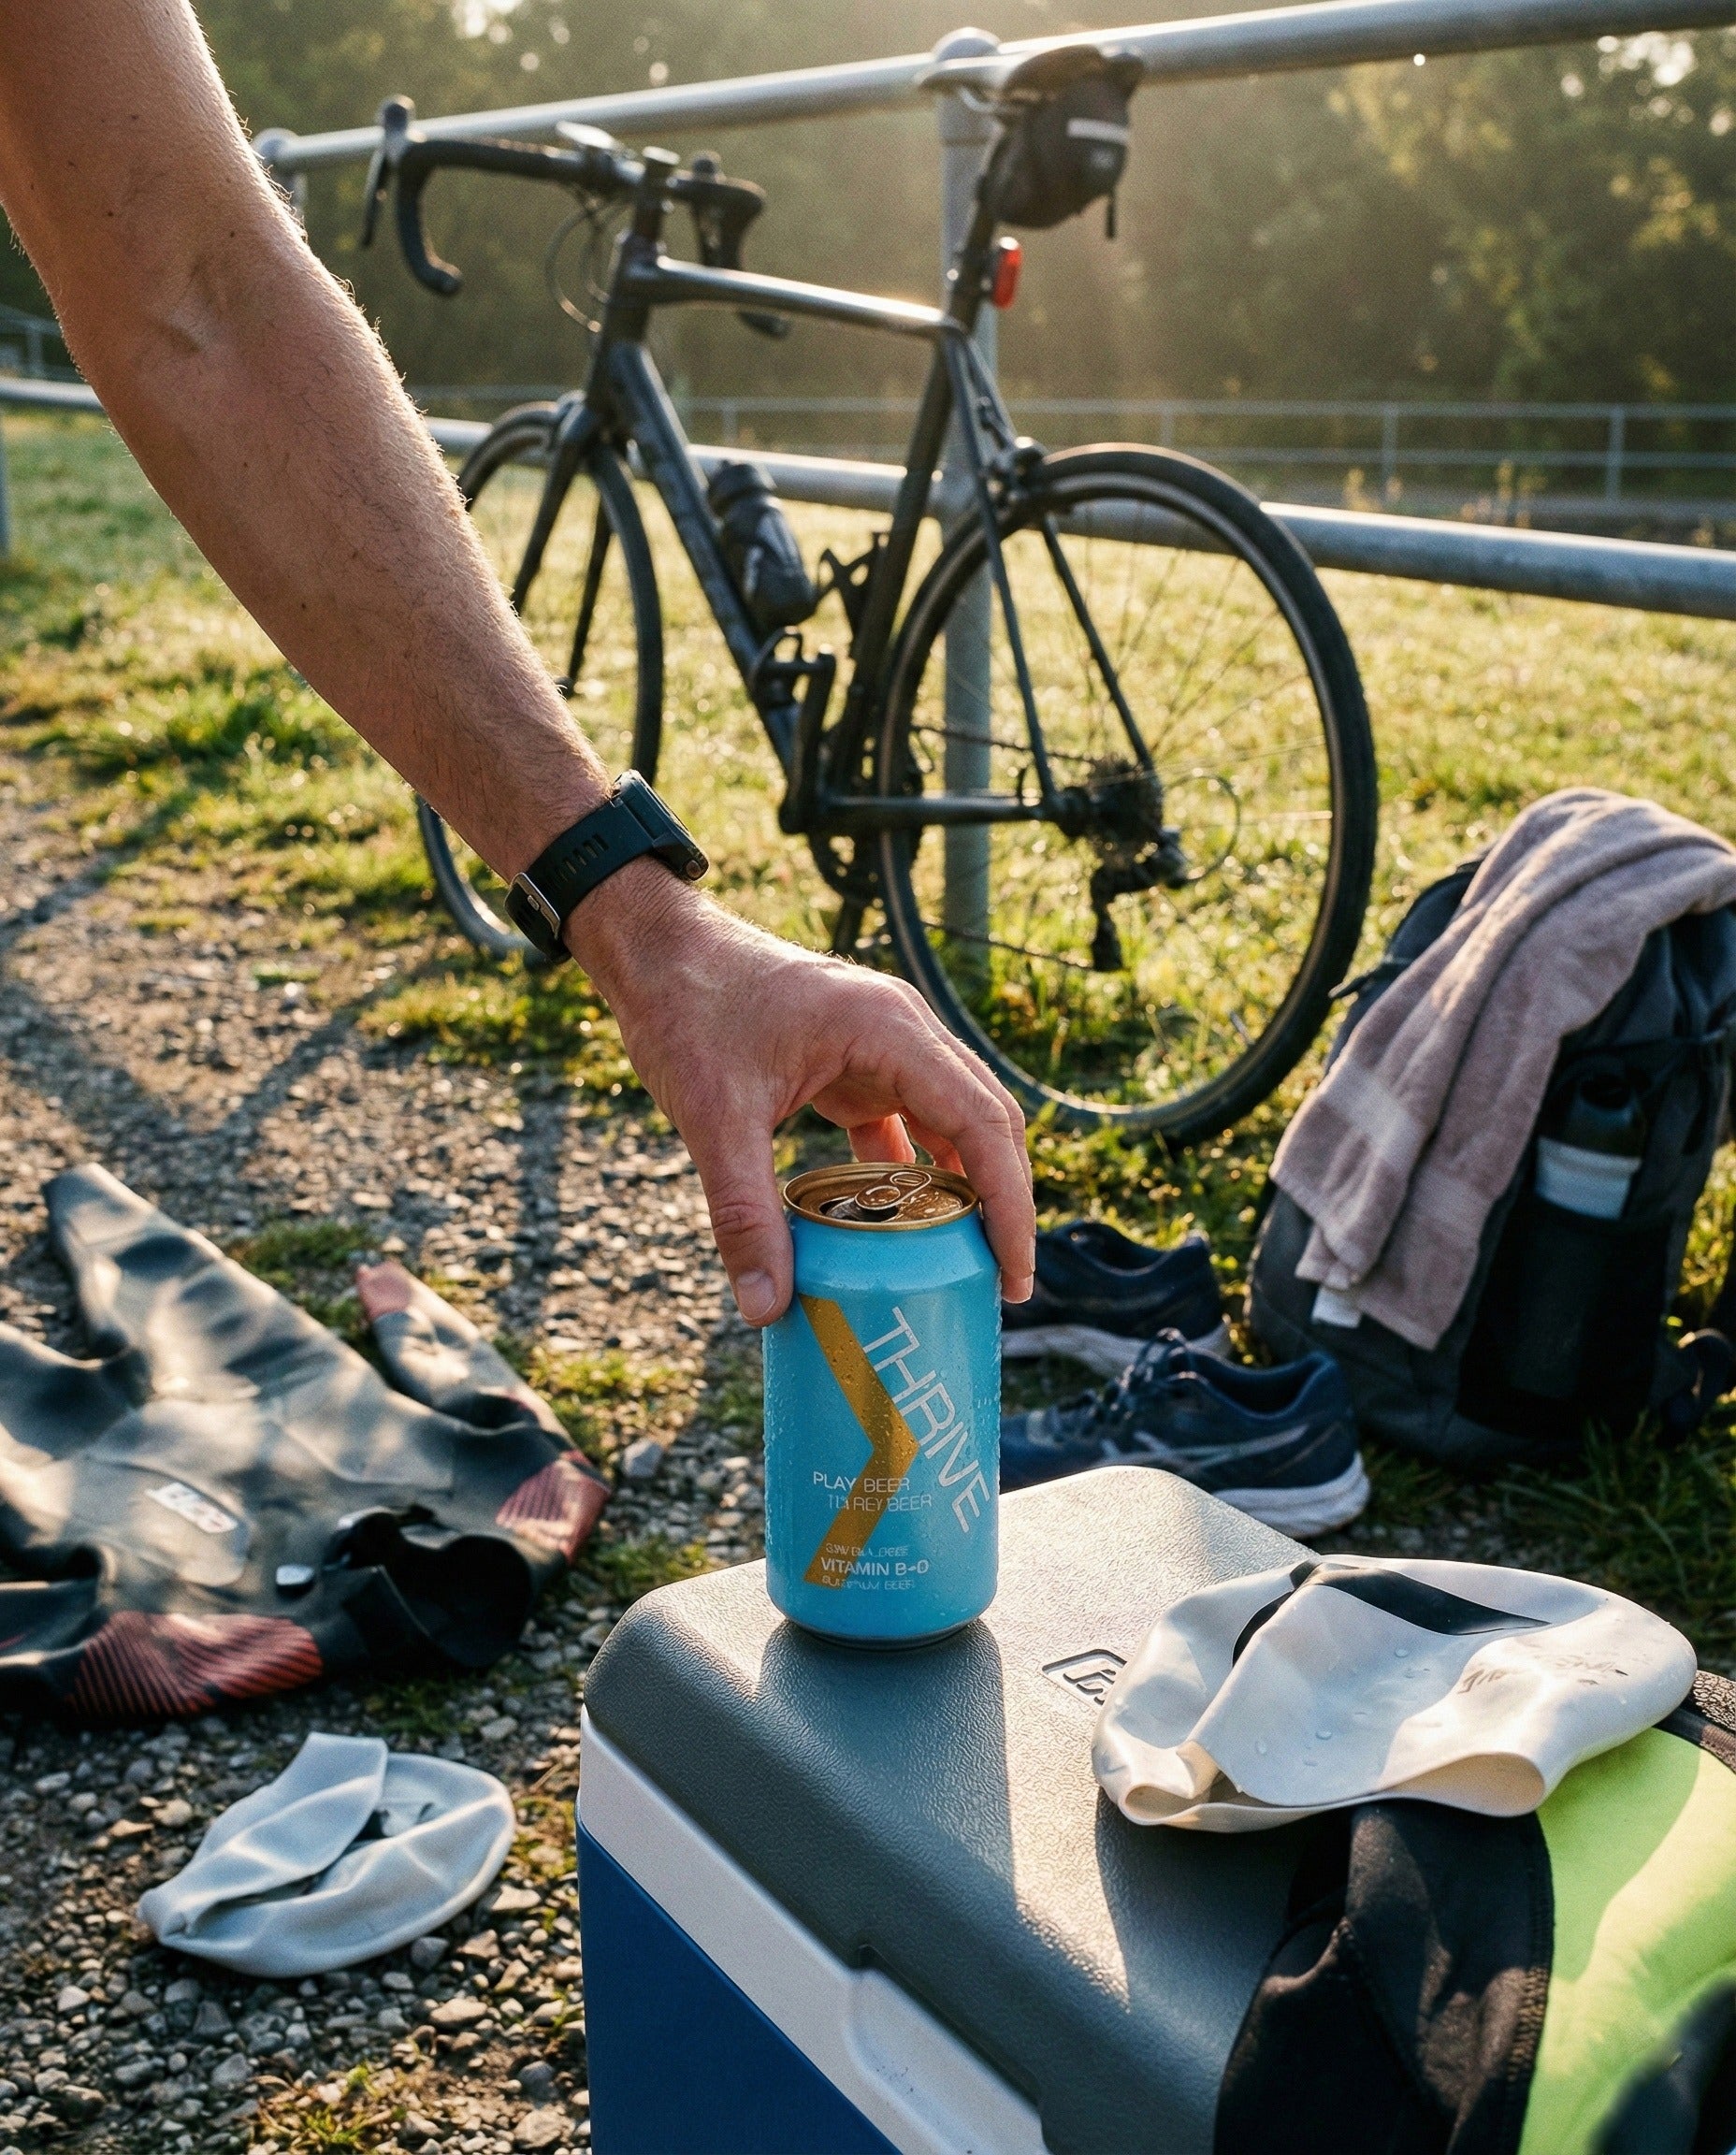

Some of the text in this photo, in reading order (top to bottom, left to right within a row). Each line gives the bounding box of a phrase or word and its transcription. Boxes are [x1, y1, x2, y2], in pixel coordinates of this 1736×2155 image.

[862, 1306, 991, 1533] THRIVE
[813, 1471, 910, 1493] PLAY BEER
[820, 1556, 890, 1576] VITAMIN
